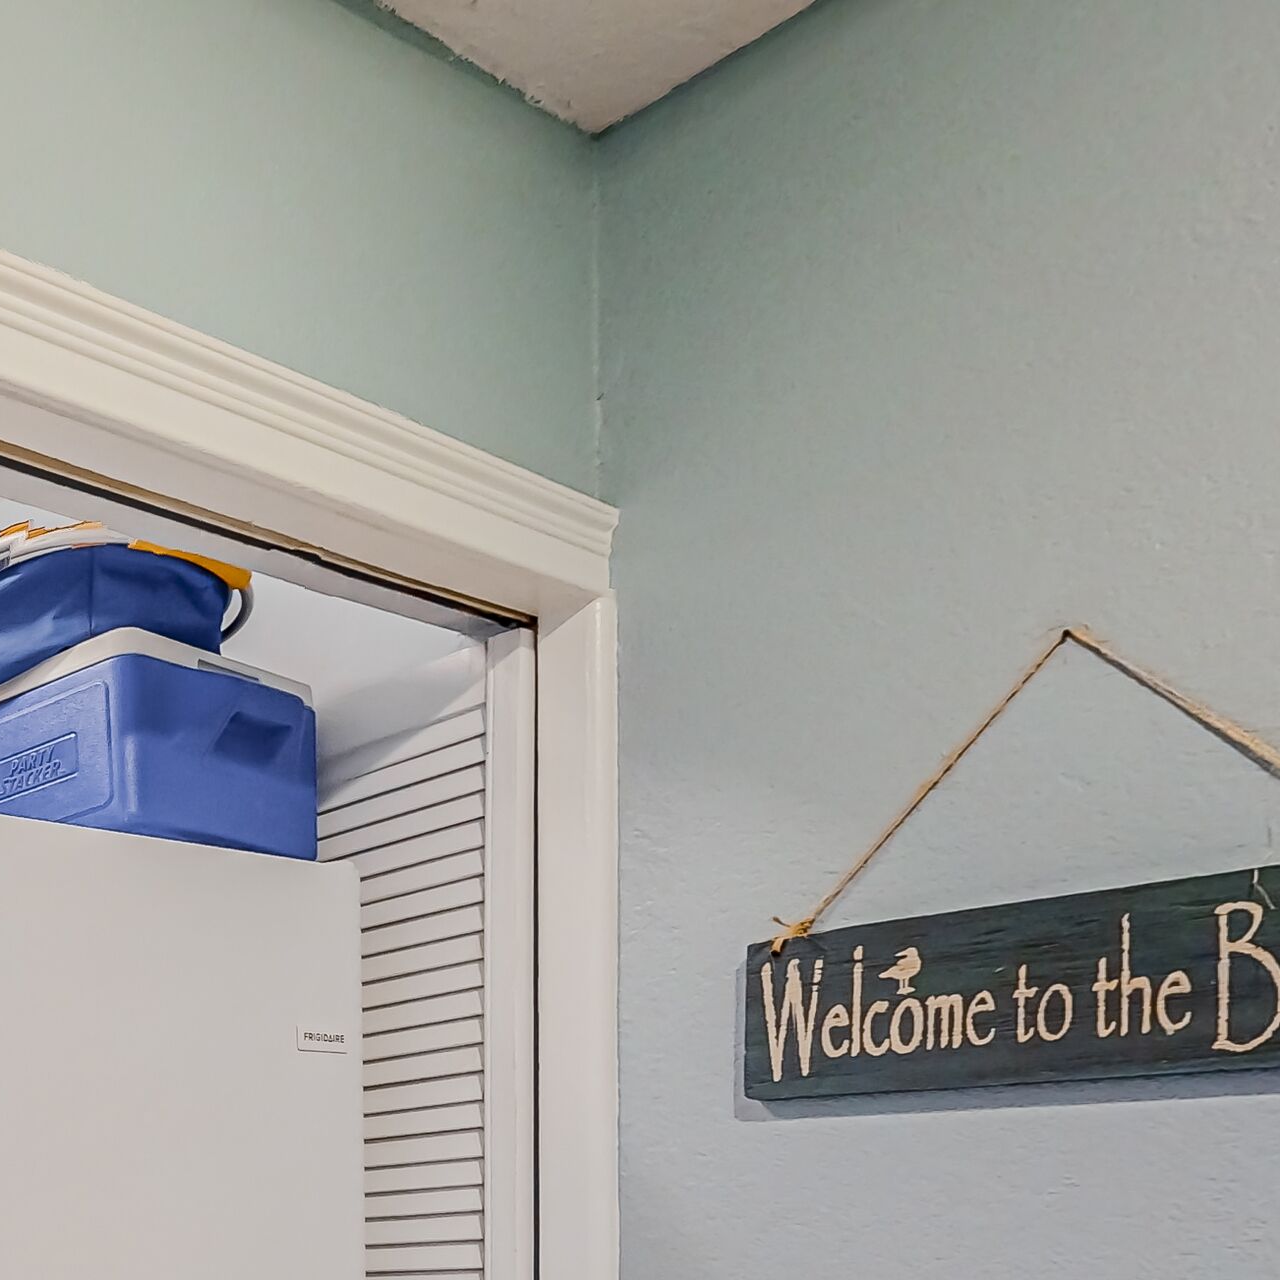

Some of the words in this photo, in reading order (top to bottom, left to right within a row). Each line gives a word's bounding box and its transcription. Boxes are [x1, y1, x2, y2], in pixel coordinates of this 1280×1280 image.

[9, 744, 56, 778] PARTY
[760, 945, 997, 1083] Welcome
[1012, 964, 1073, 1043] to
[1091, 911, 1193, 1039] the
[303, 1032, 345, 1044] FRIGIDAIRE
